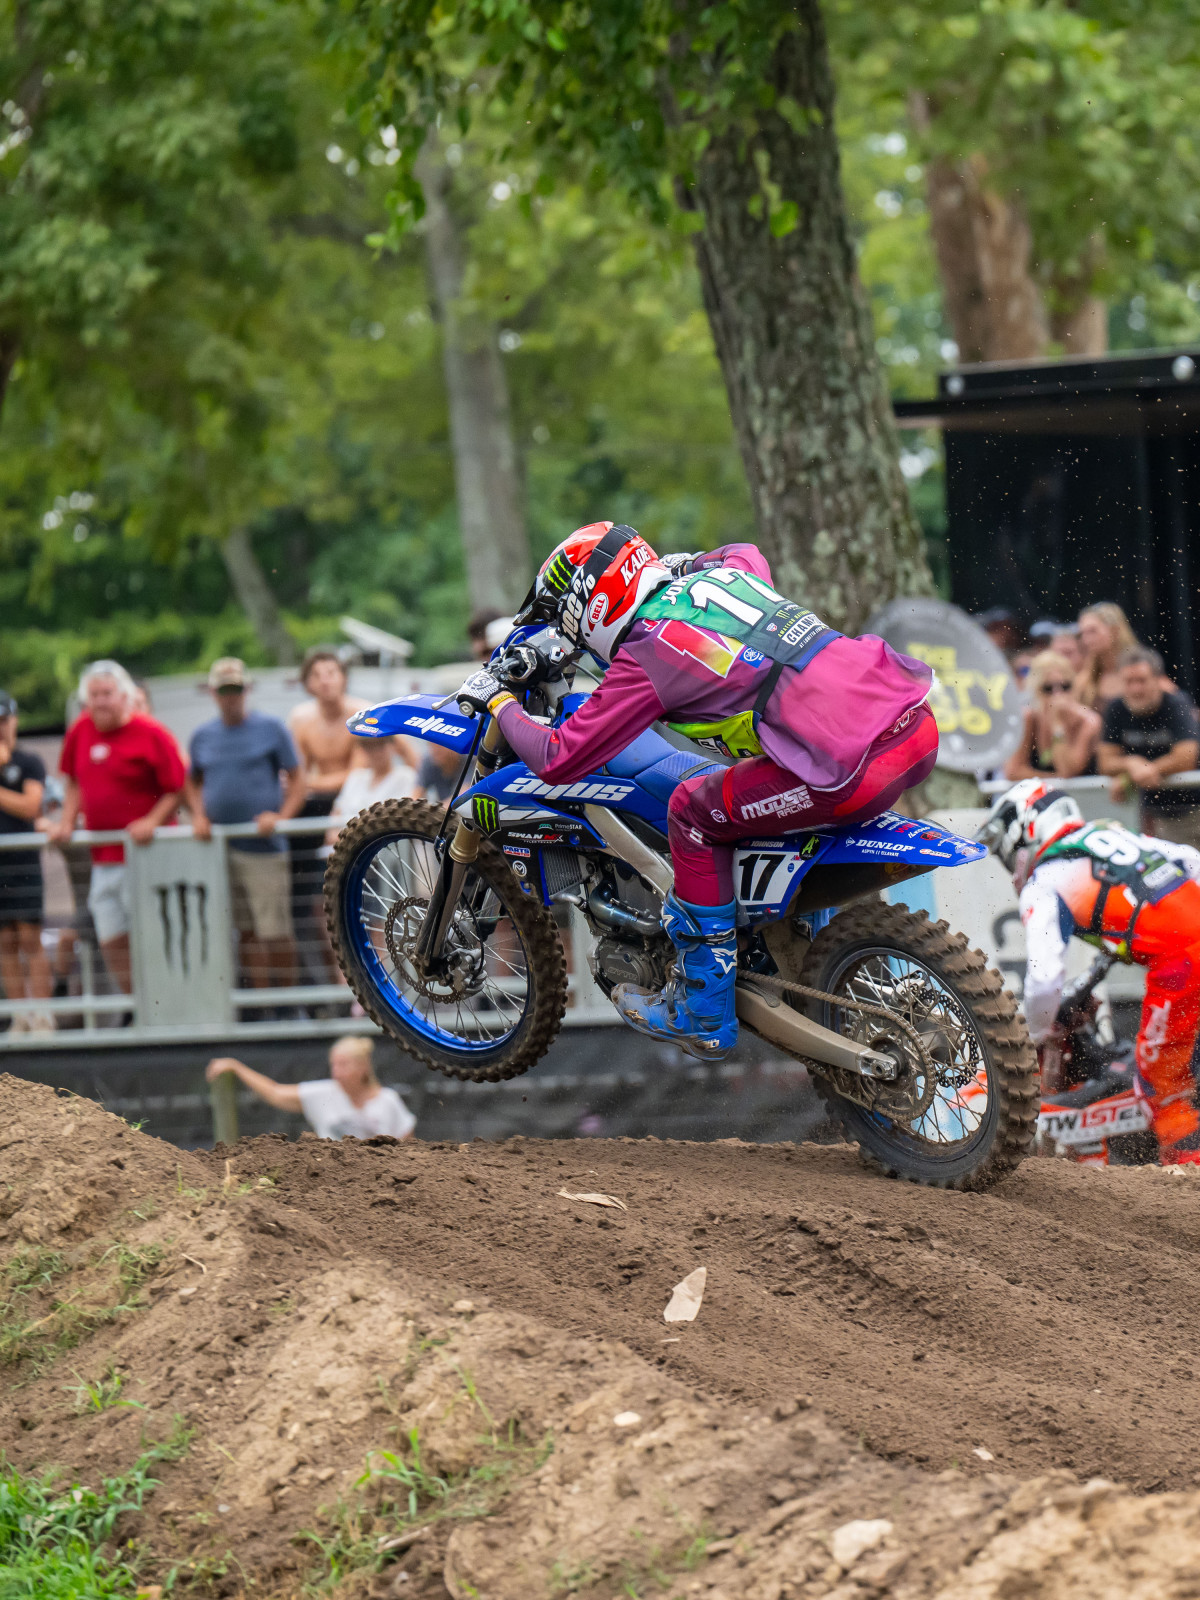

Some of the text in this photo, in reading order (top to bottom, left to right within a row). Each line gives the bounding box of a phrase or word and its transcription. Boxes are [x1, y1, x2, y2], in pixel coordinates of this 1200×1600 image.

[620, 545, 651, 587] KADE
[592, 597, 606, 621] BELL
[687, 567, 789, 631] 17
[741, 784, 811, 820] MOOSE
[776, 800, 815, 819] RACING
[507, 831, 543, 839] SWAN
[751, 840, 785, 849] JOHNSON
[856, 839, 915, 852] DUNLOP
[738, 853, 787, 901] 17
